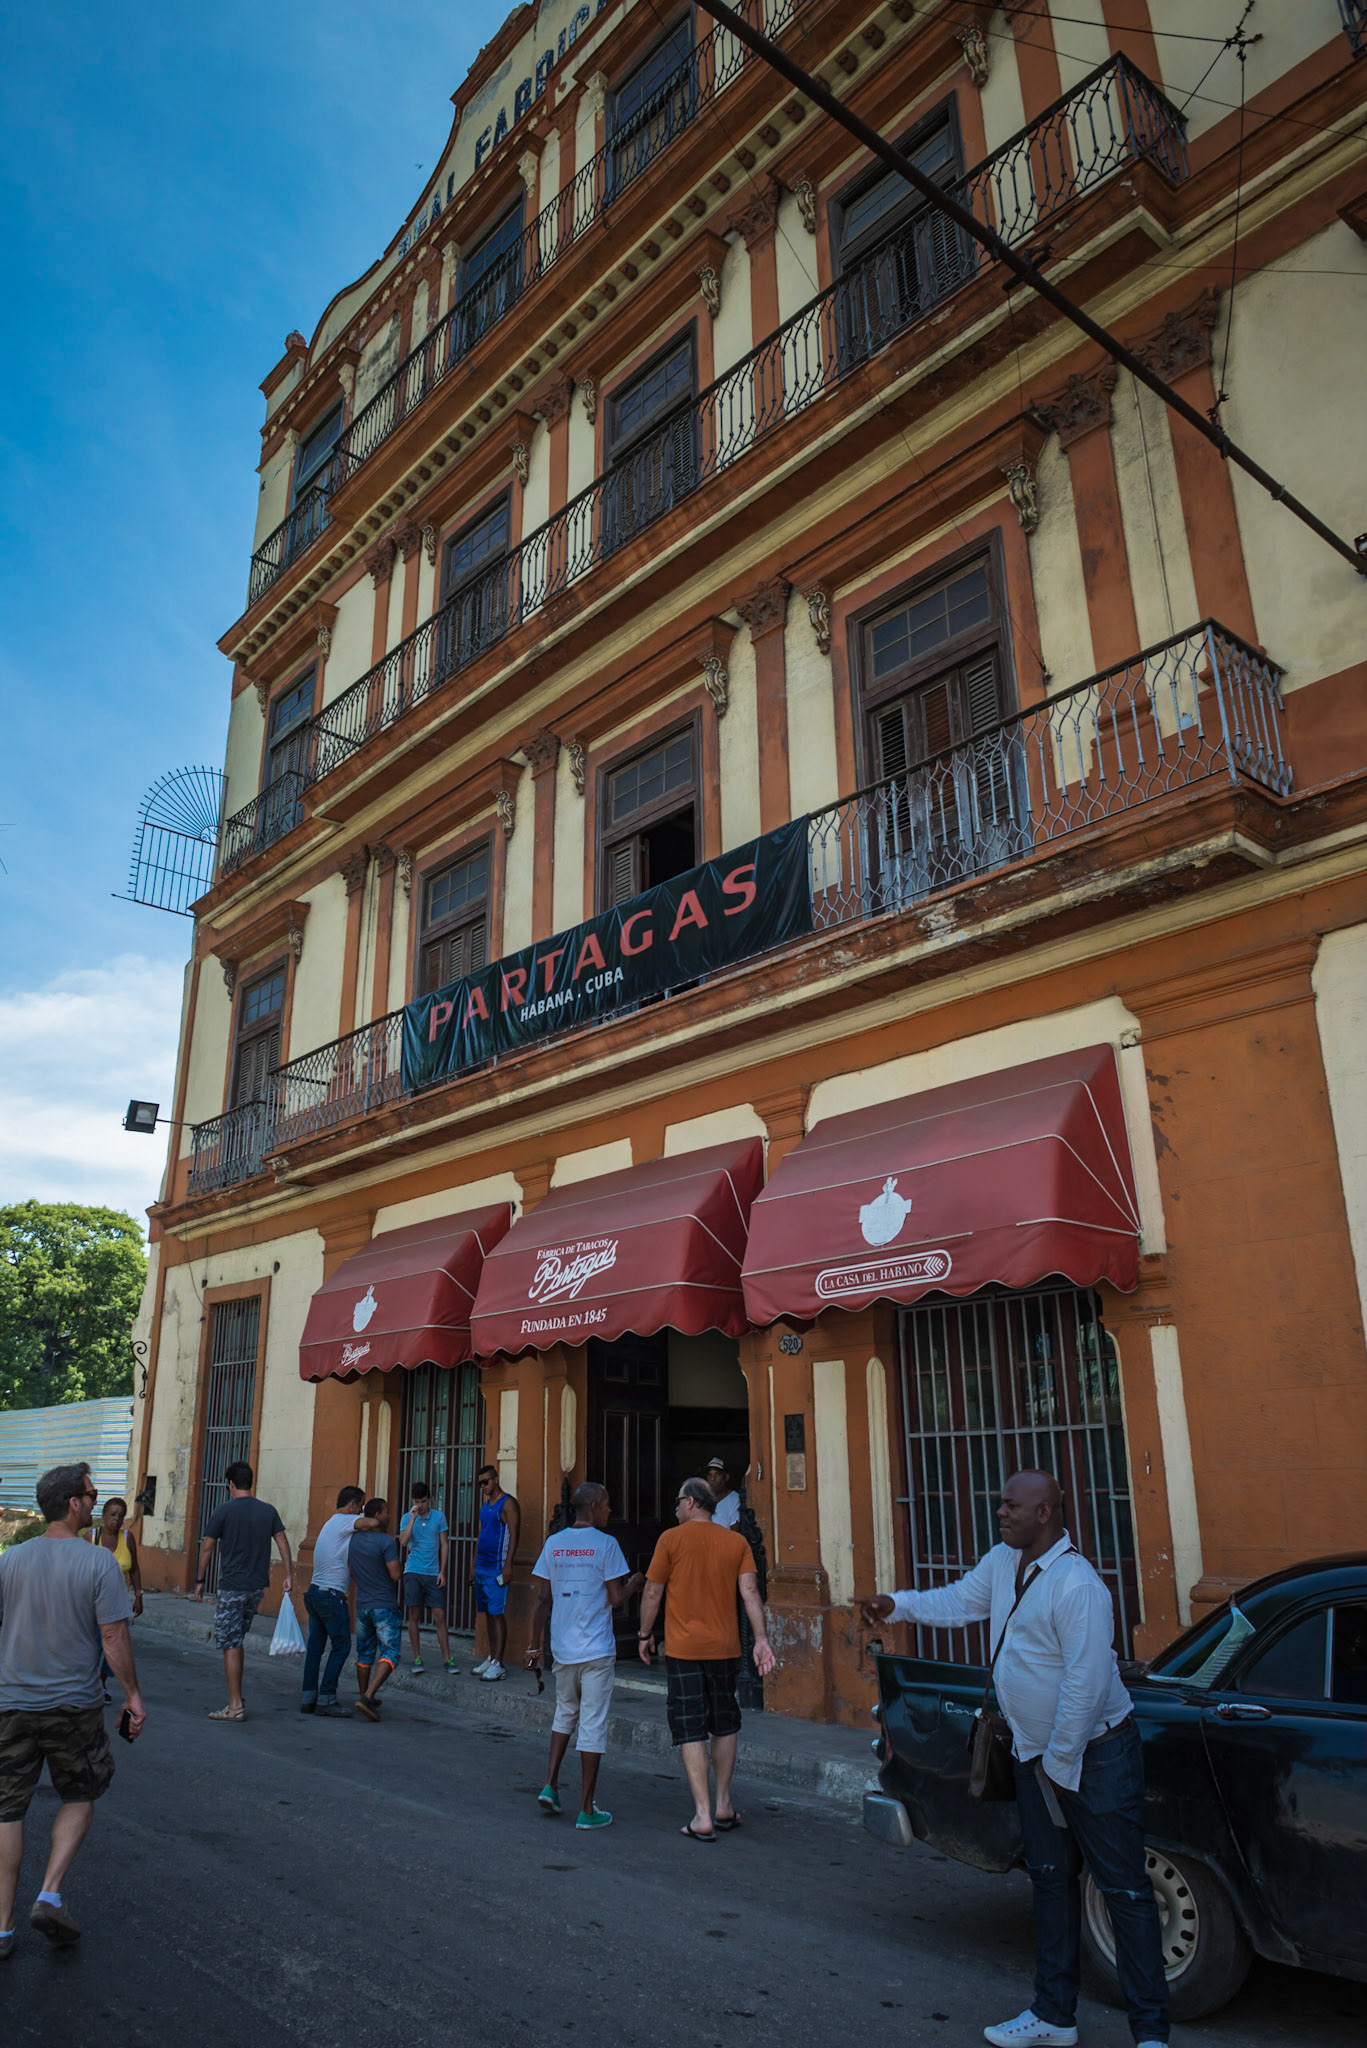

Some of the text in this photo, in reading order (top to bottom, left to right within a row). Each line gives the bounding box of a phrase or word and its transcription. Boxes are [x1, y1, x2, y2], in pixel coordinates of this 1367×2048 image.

[428, 863, 757, 1043] PARTAGAS
[520, 966, 624, 1022] HABANA CUBA
[565, 1244, 576, 1255] DE
[576, 1238, 608, 1252] TABACOS
[824, 1262, 923, 1290] LA CASA DEL HABANO
[521, 1308, 608, 1334] FUNDADA EN 1845
[783, 1337, 799, 1352] 520
[552, 1549, 595, 1557] GET DRESSED
